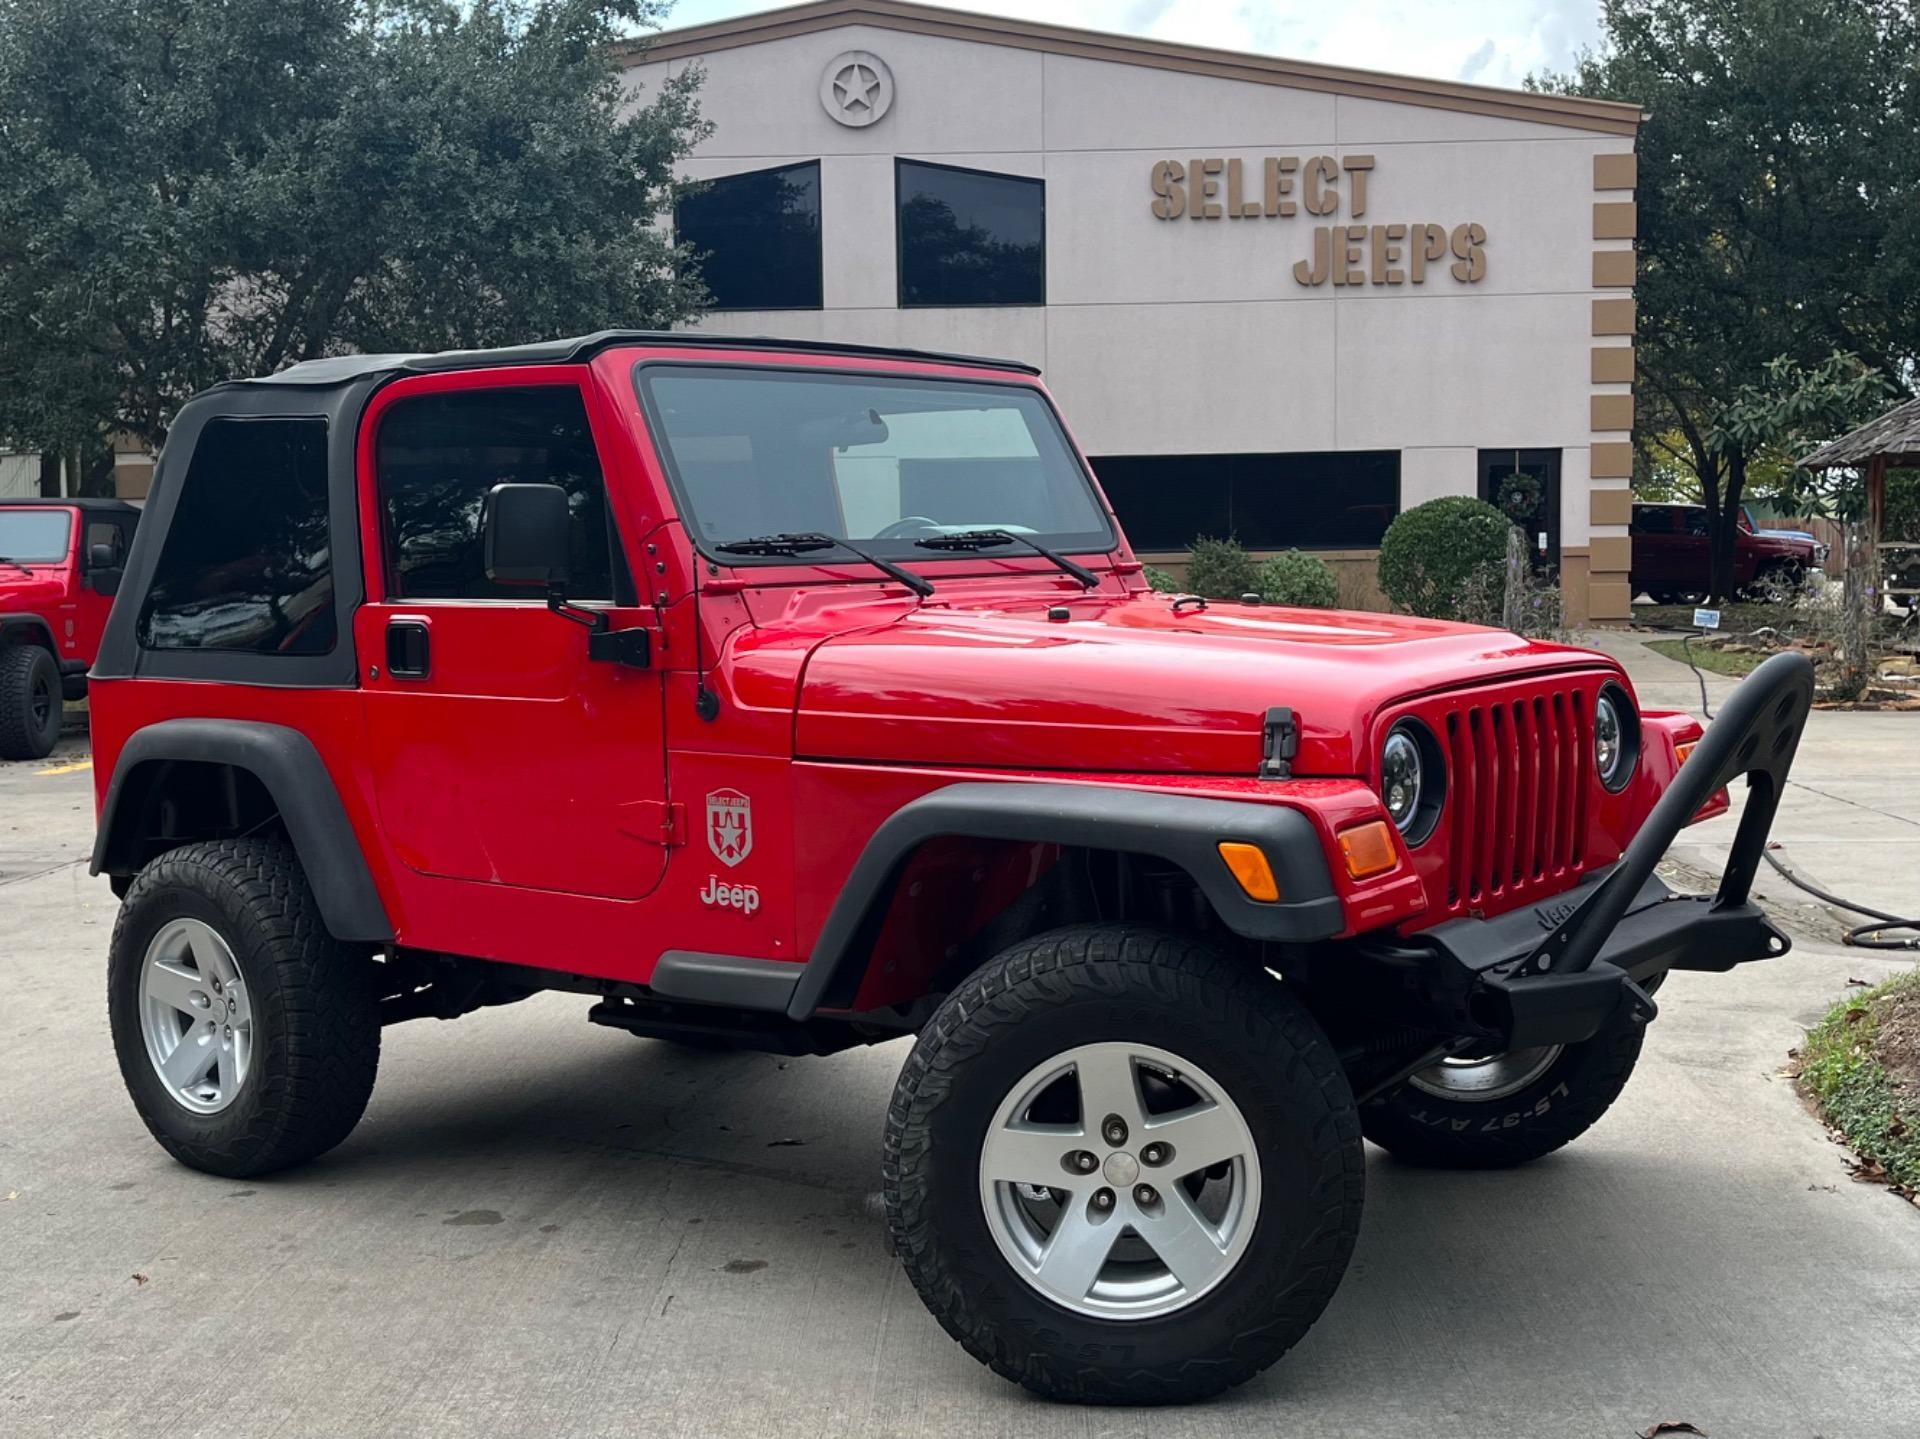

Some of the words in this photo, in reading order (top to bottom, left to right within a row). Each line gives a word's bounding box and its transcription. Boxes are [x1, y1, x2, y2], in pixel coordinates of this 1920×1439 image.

[1151, 154, 1375, 220] SELECT
[1293, 222, 1487, 286] JEEPS
[700, 875, 759, 915] Jeep
